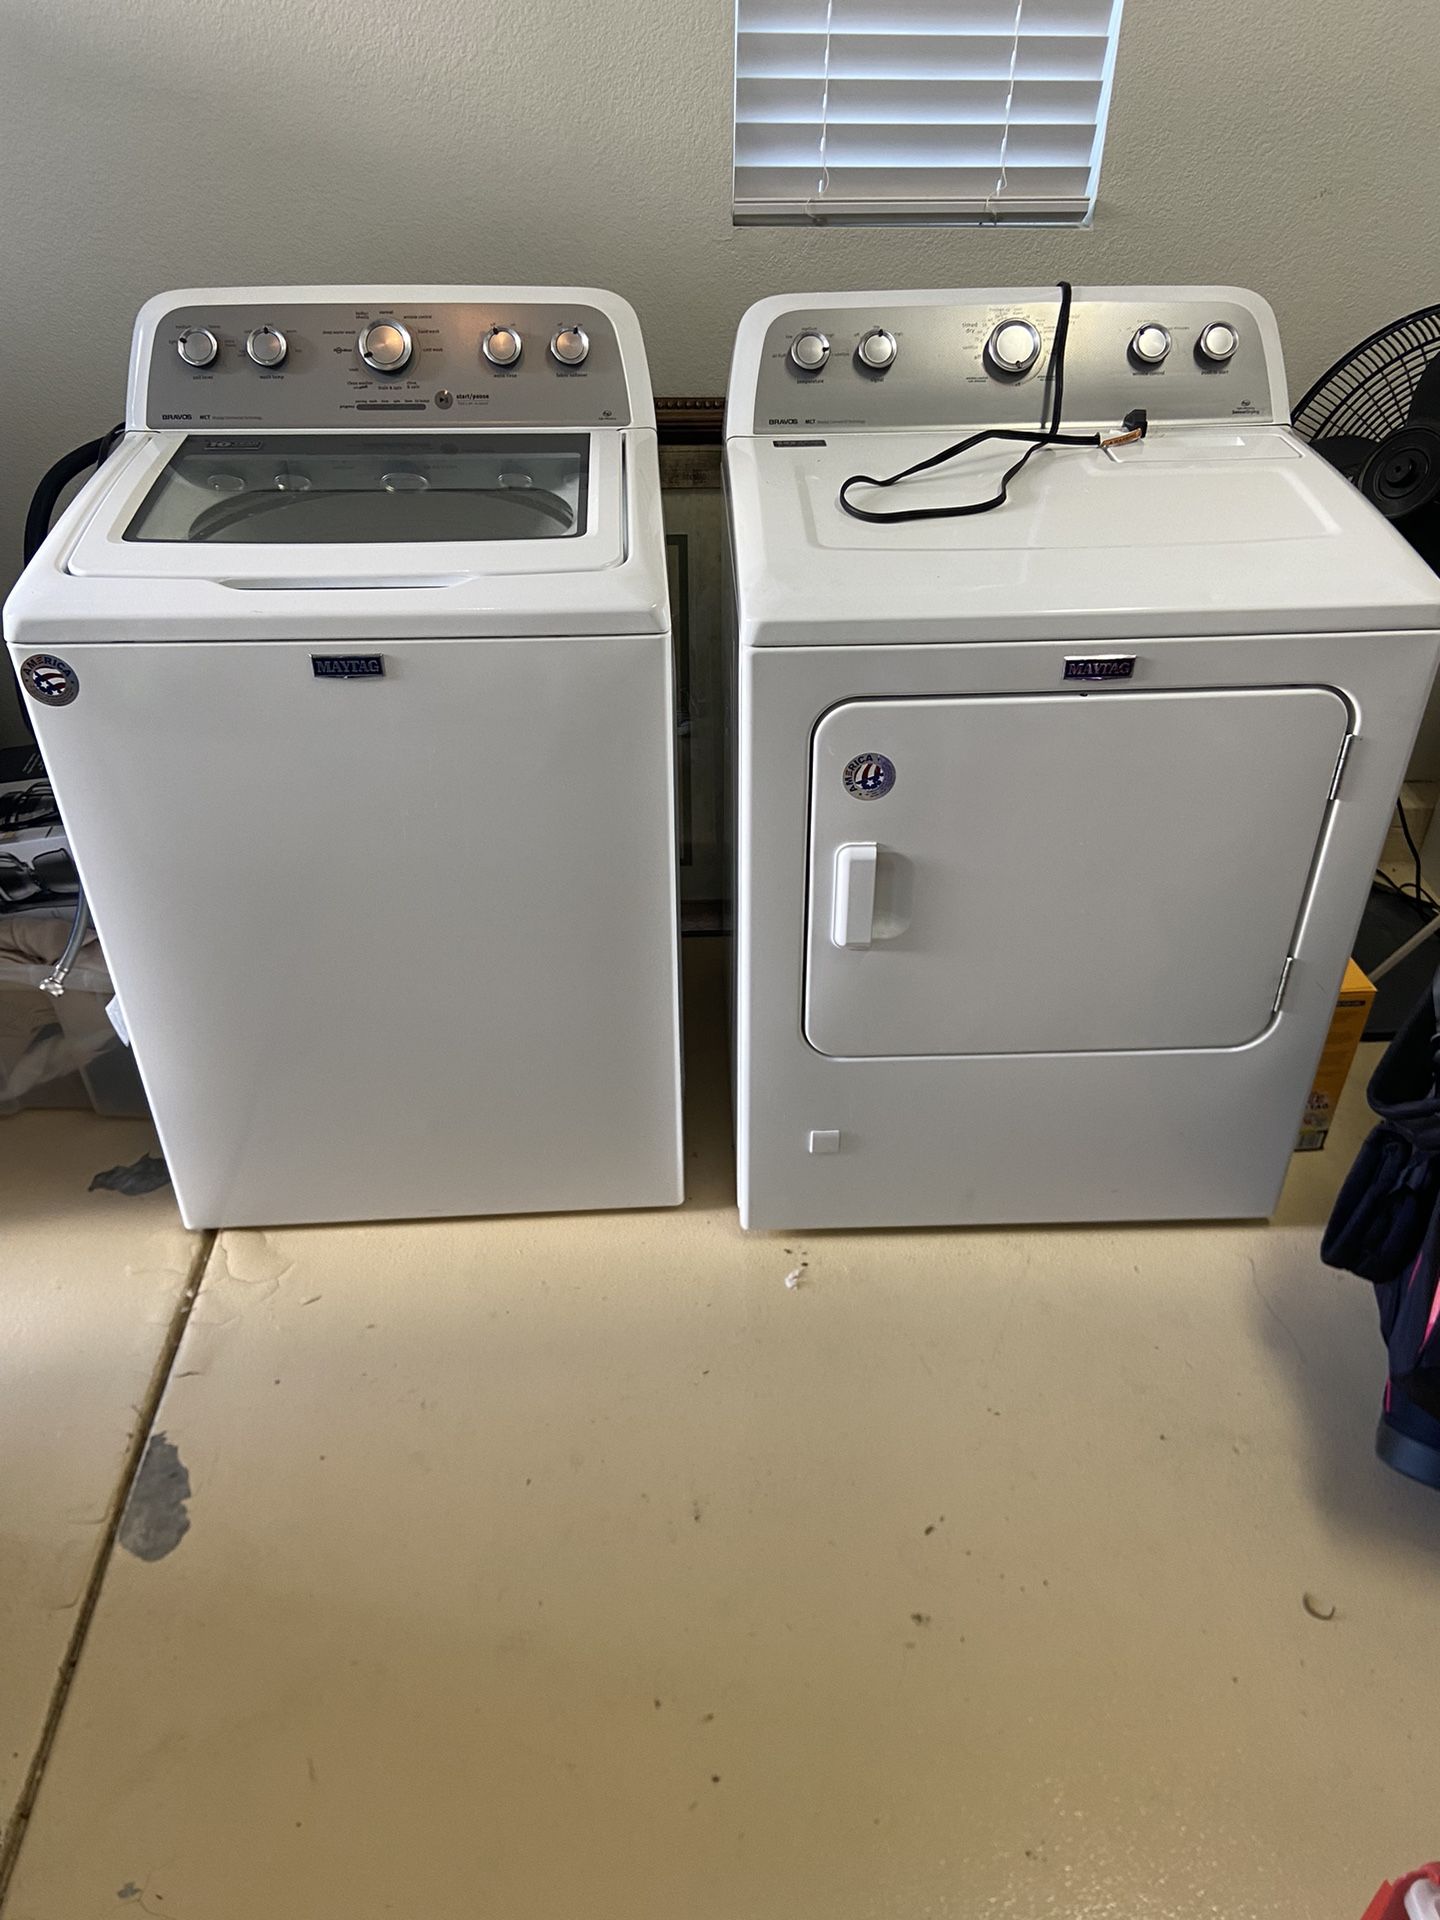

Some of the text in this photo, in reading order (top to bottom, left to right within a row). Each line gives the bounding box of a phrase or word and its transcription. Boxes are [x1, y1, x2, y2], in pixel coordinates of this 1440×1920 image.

[23, 656, 71, 677] AMERICA
[315, 660, 380, 673] MAYTAG
[1067, 662, 1130, 675] MAYTAG
[845, 754, 873, 792] AMERICA
